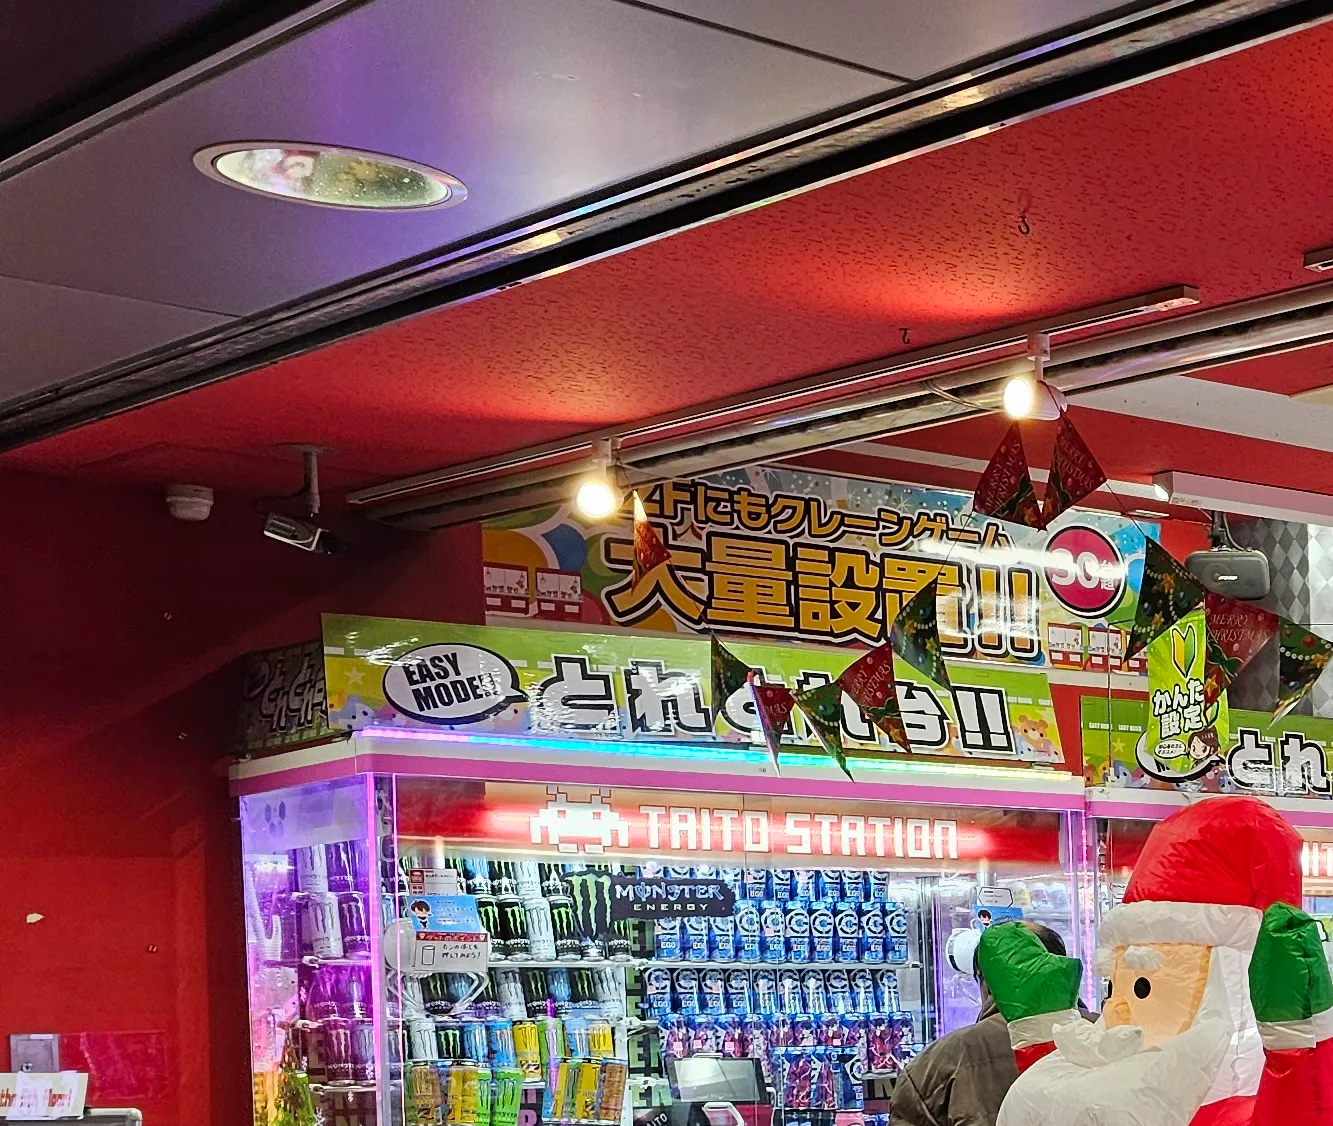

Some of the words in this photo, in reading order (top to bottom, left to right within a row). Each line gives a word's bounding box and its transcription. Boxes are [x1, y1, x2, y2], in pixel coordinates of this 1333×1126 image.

[404, 652, 460, 687] EASY
[412, 672, 502, 714] MODE!!
[638, 804, 769, 852] TAITO
[786, 810, 959, 860] STATION
[615, 879, 726, 901] MONSTER
[633, 903, 709, 913] ENERGY
